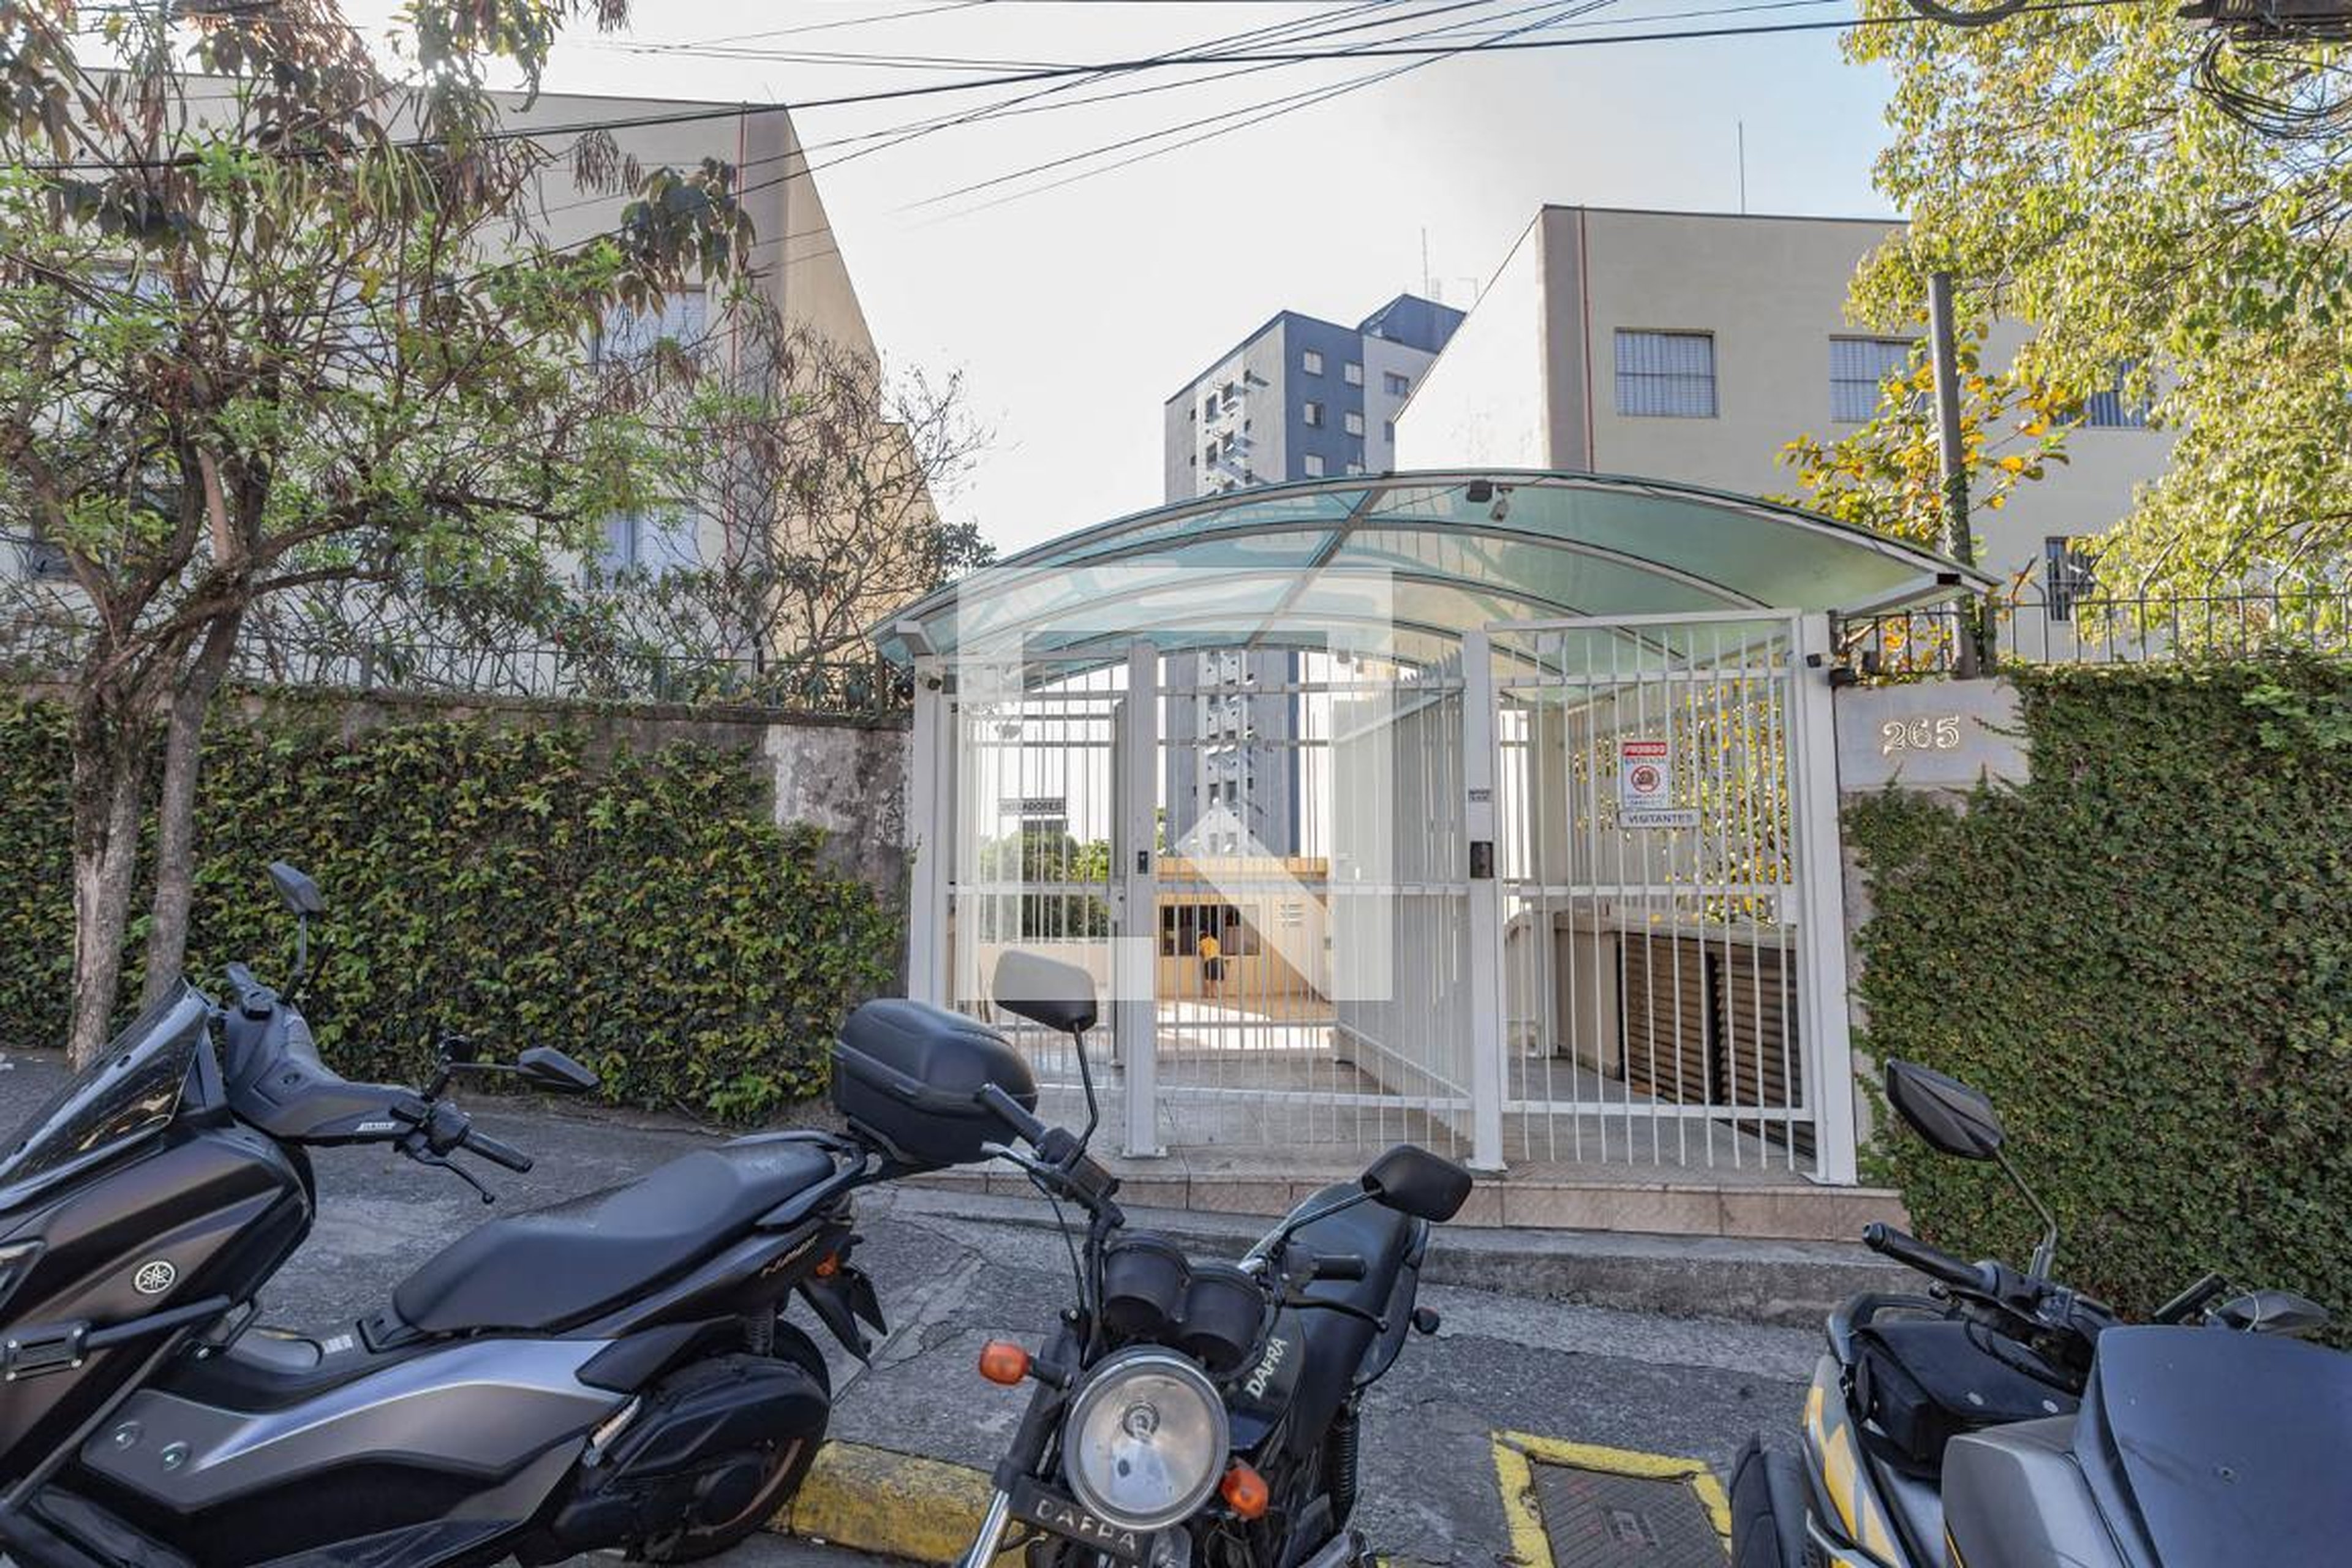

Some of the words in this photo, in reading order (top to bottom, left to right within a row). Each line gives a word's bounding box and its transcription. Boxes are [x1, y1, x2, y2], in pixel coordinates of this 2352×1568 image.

[1882, 715, 1960, 755] 265
[1629, 814, 1693, 824] VISITANTES
[1244, 1338, 1288, 1400] DAFRA
